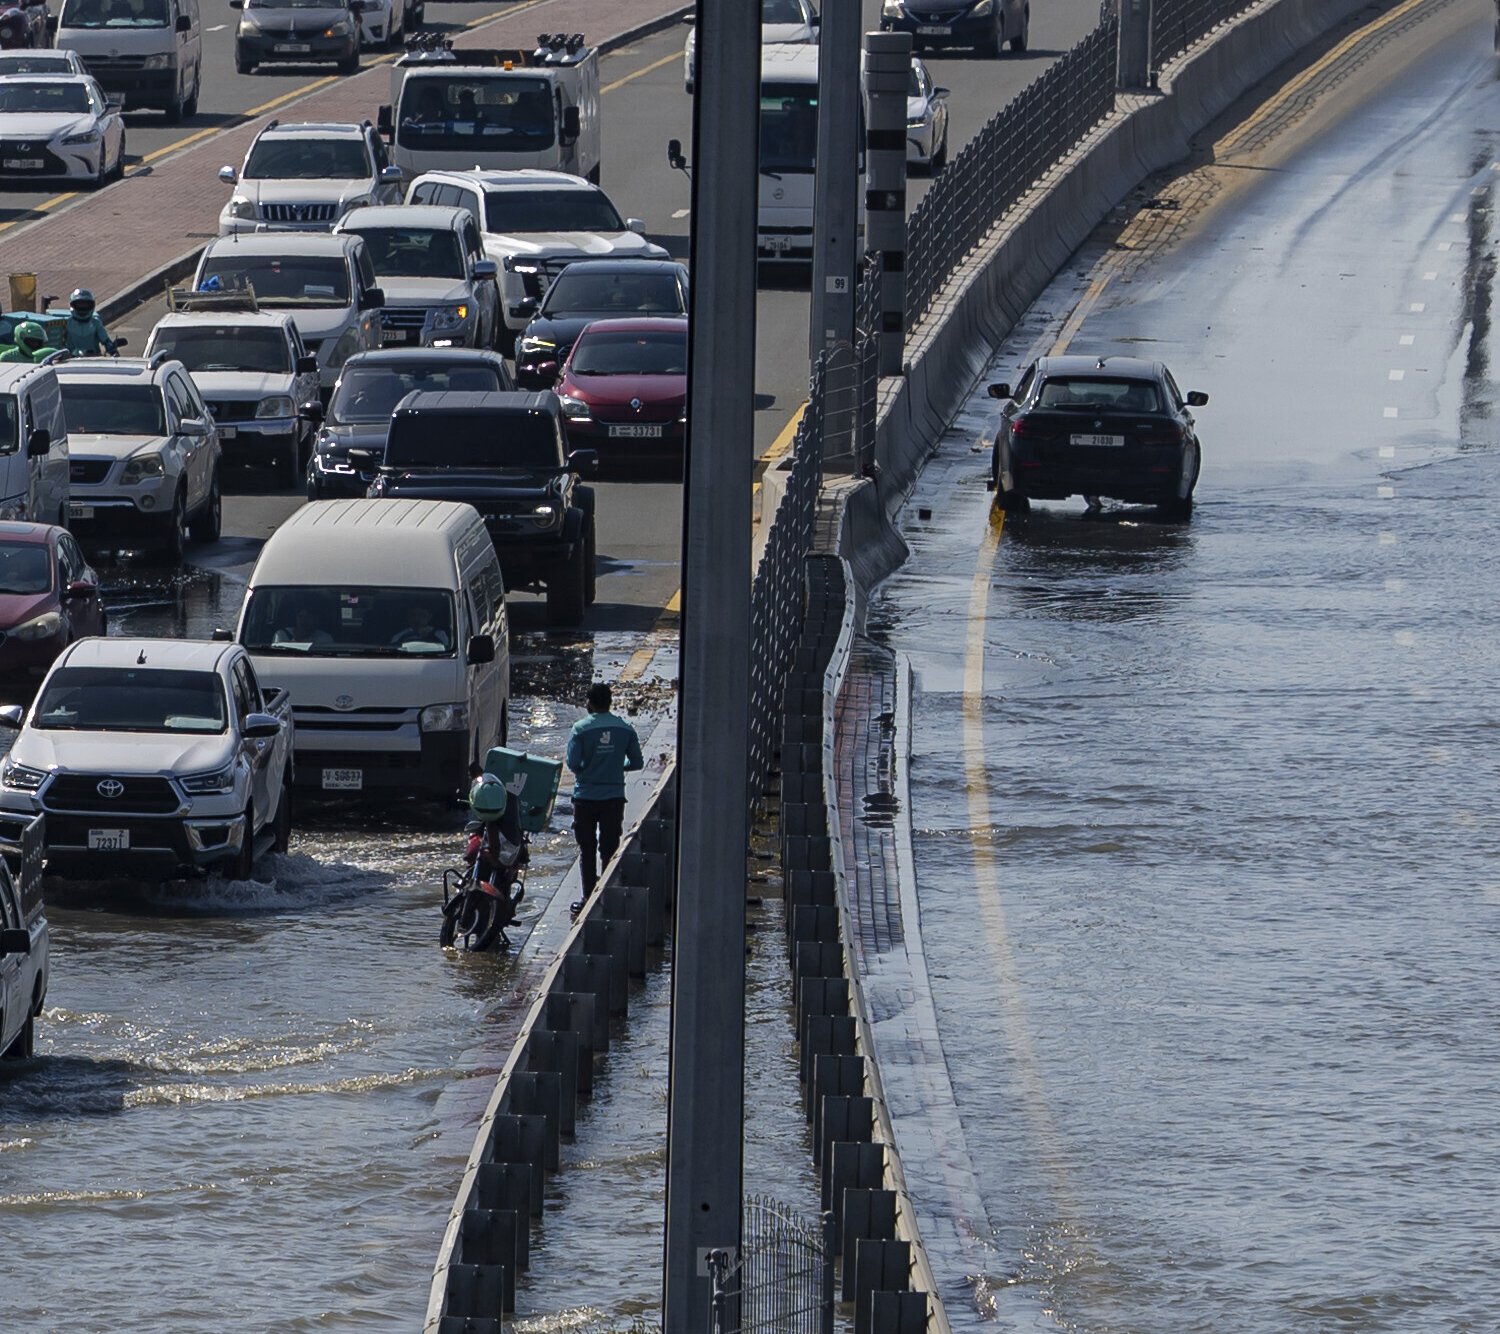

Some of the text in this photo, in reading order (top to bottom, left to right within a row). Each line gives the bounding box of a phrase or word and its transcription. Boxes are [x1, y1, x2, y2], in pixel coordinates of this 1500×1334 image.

[835, 278, 845, 289] 99
[633, 427, 661, 437] 33731
[97, 837, 123, 849] 72371
